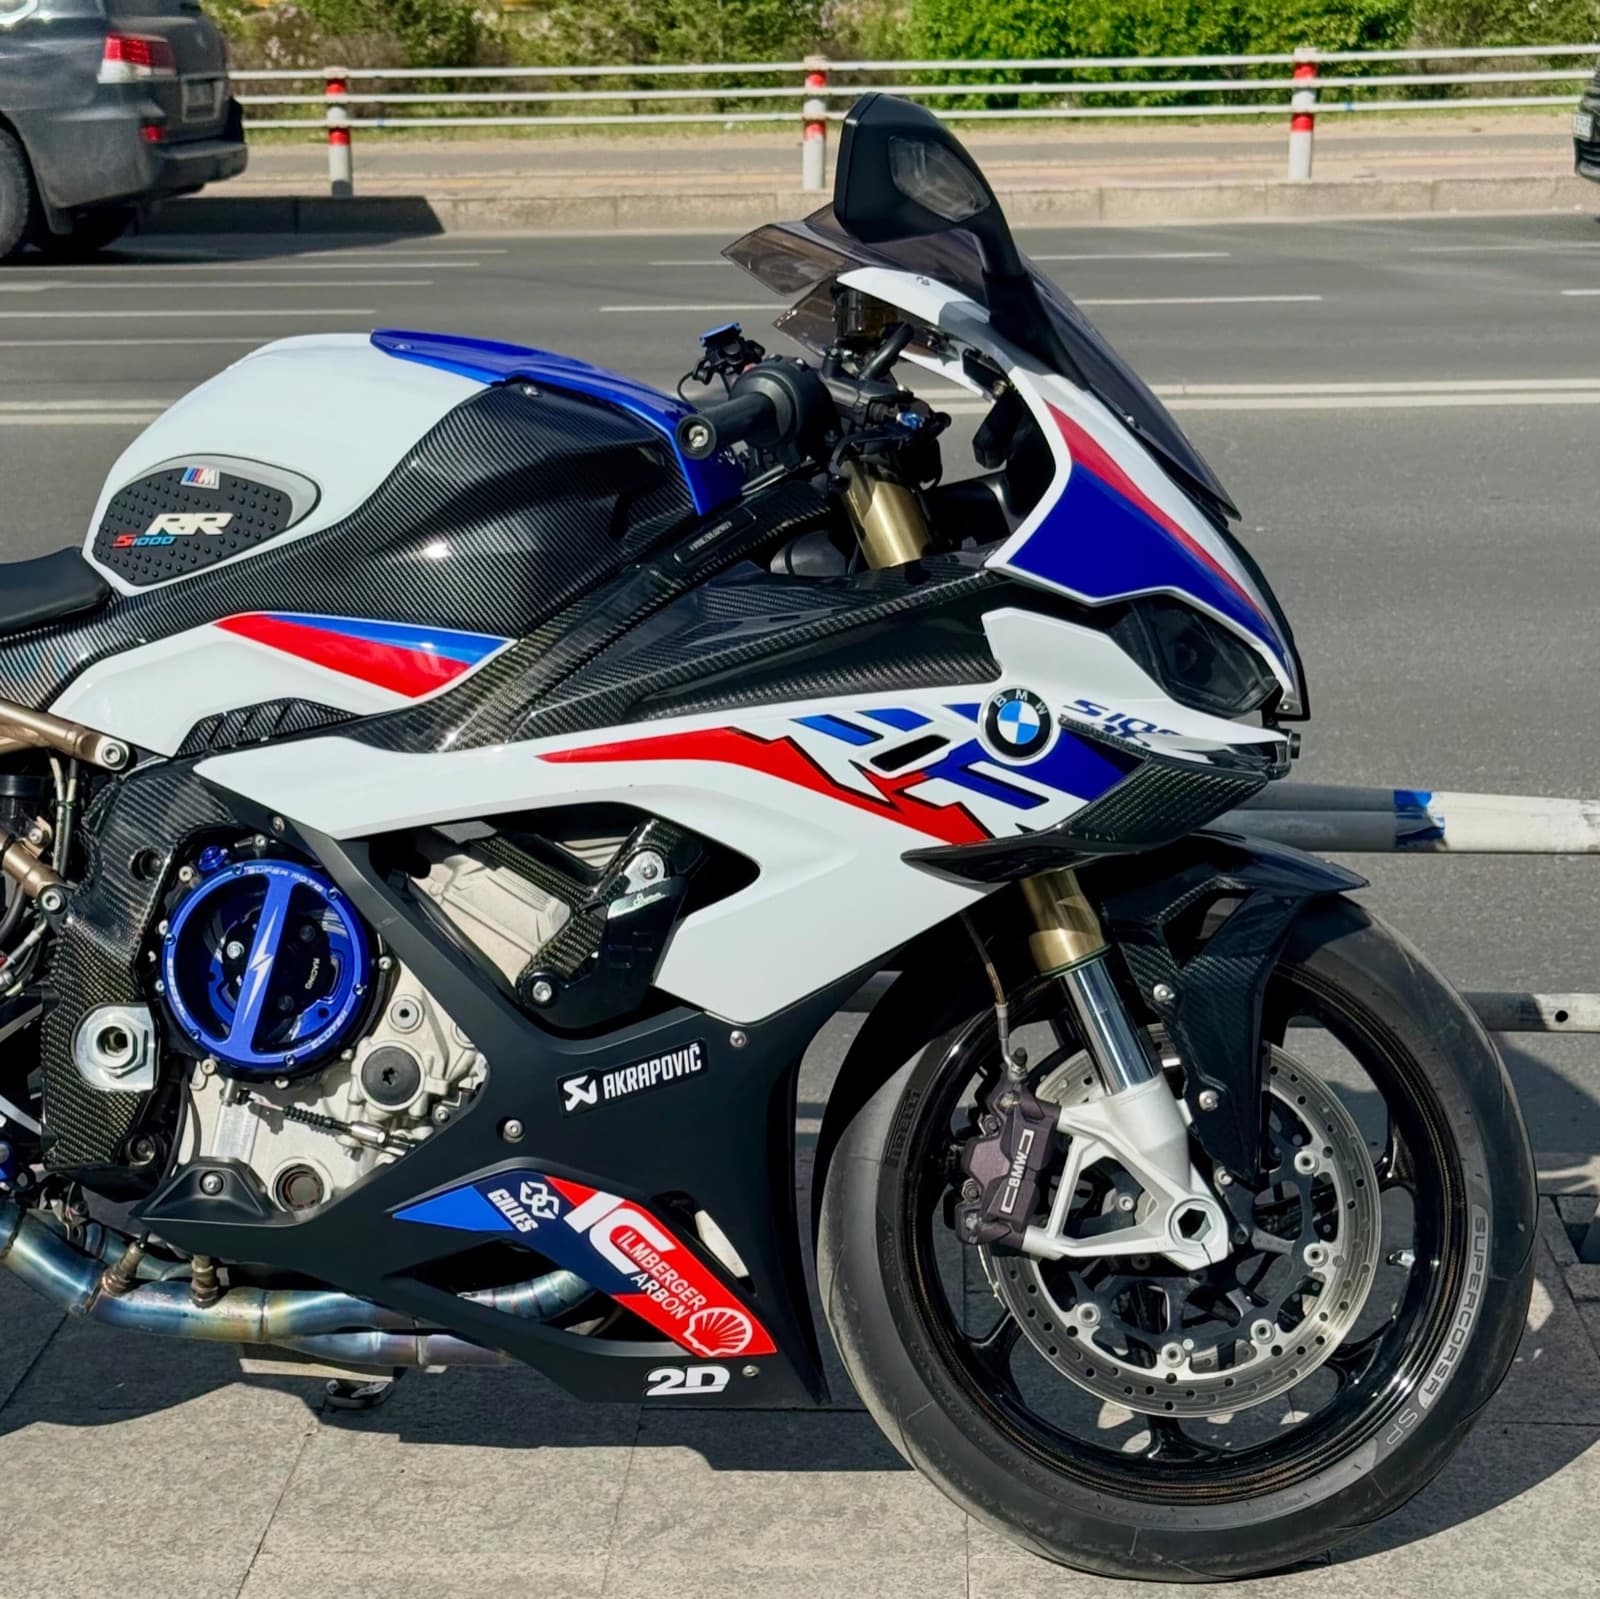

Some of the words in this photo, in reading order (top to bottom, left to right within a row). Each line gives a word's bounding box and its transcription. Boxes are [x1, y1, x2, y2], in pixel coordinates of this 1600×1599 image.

[113, 534, 176, 548] S1000
[144, 512, 234, 536] RR
[993, 688, 1048, 715] BMW
[304, 957, 321, 990] RACING
[1008, 1151, 1028, 1189] BMW
[487, 1188, 539, 1233] GILLES
[616, 1231, 707, 1311] ILMBERGER
[1424, 1215, 1487, 1396] SUPERCORSA
[646, 1365, 731, 1397] 2D
[1386, 1408, 1419, 1446] SP
